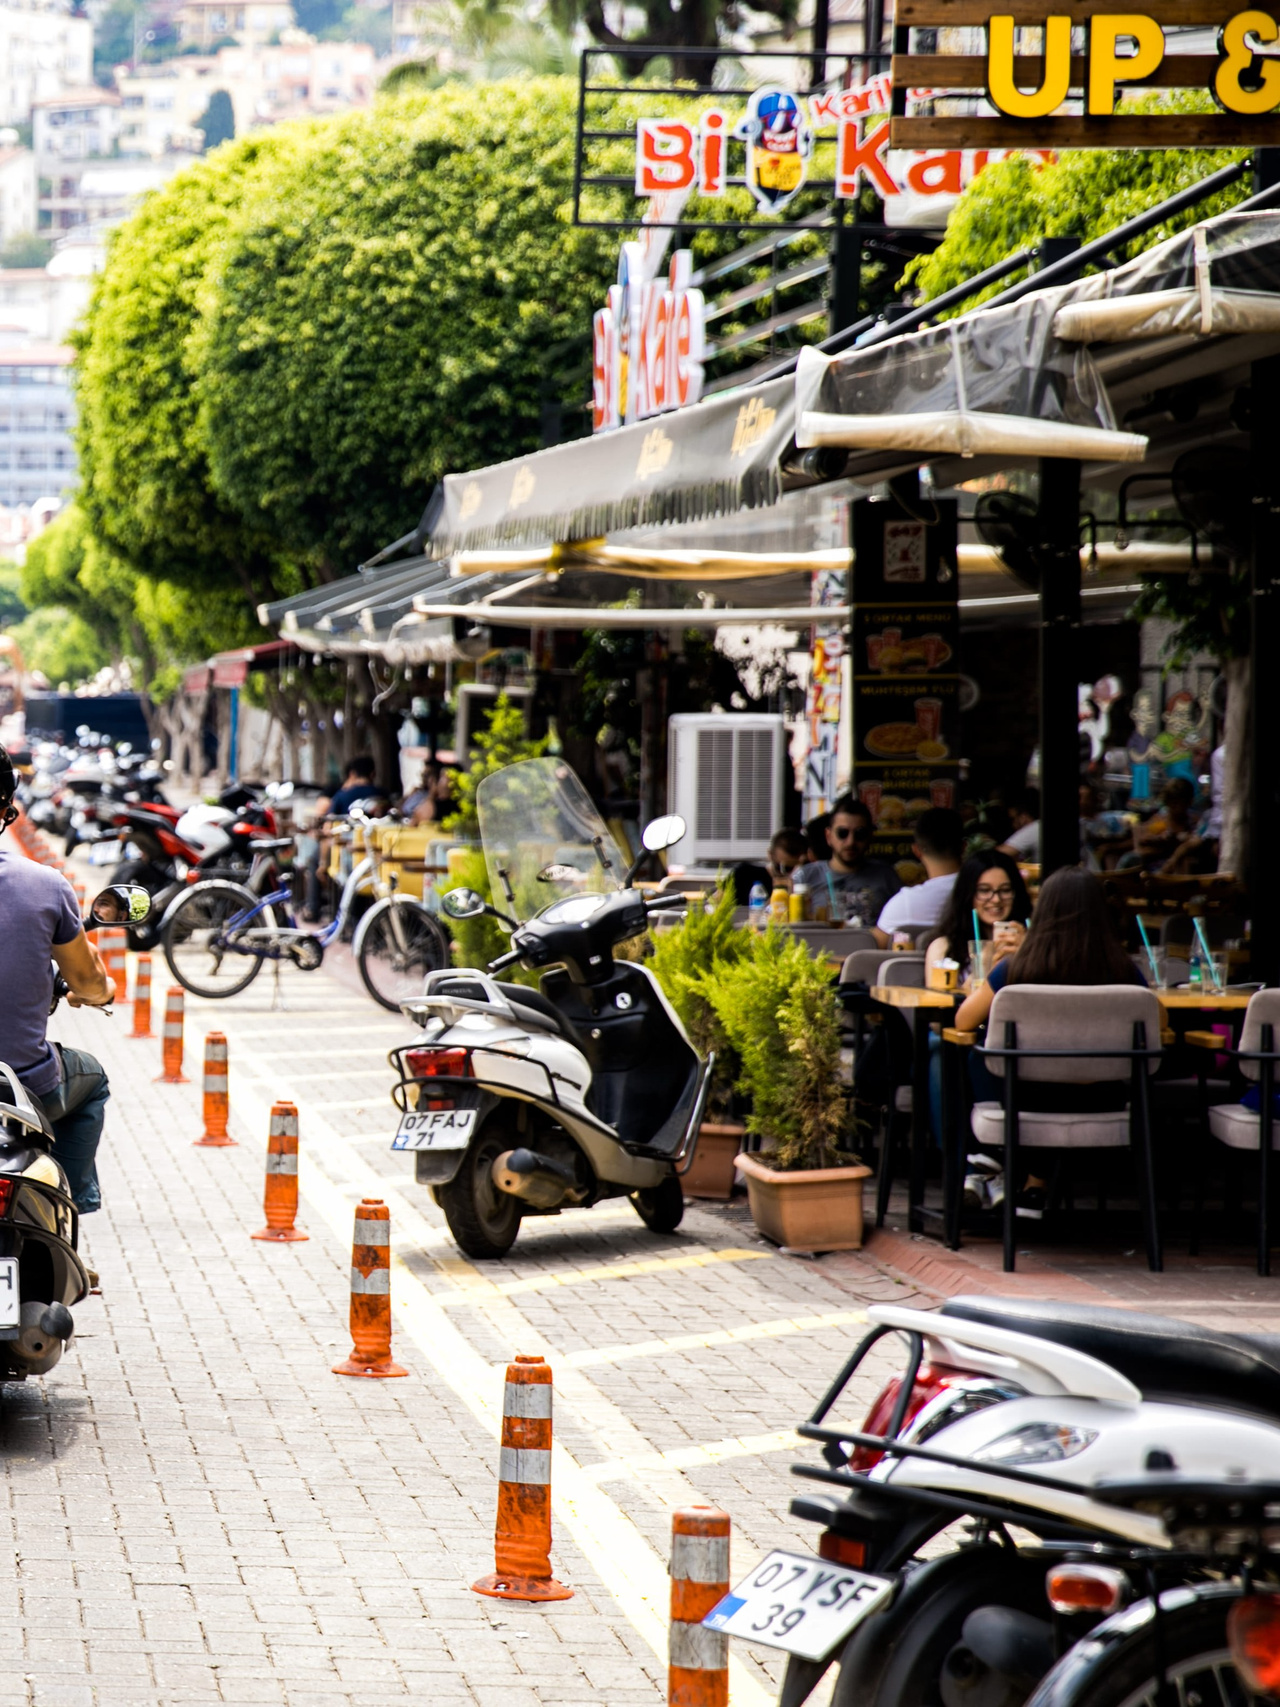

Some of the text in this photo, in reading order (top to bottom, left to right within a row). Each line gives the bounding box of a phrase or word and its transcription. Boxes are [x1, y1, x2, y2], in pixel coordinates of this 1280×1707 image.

[987, 14, 1166, 118] UP
[640, 112, 726, 193] Bi
[404, 1113, 471, 1130] 07 FAJ
[414, 1132, 435, 1146] 71
[752, 1562, 878, 1612] 07 YSF
[751, 1603, 806, 1638] 39
